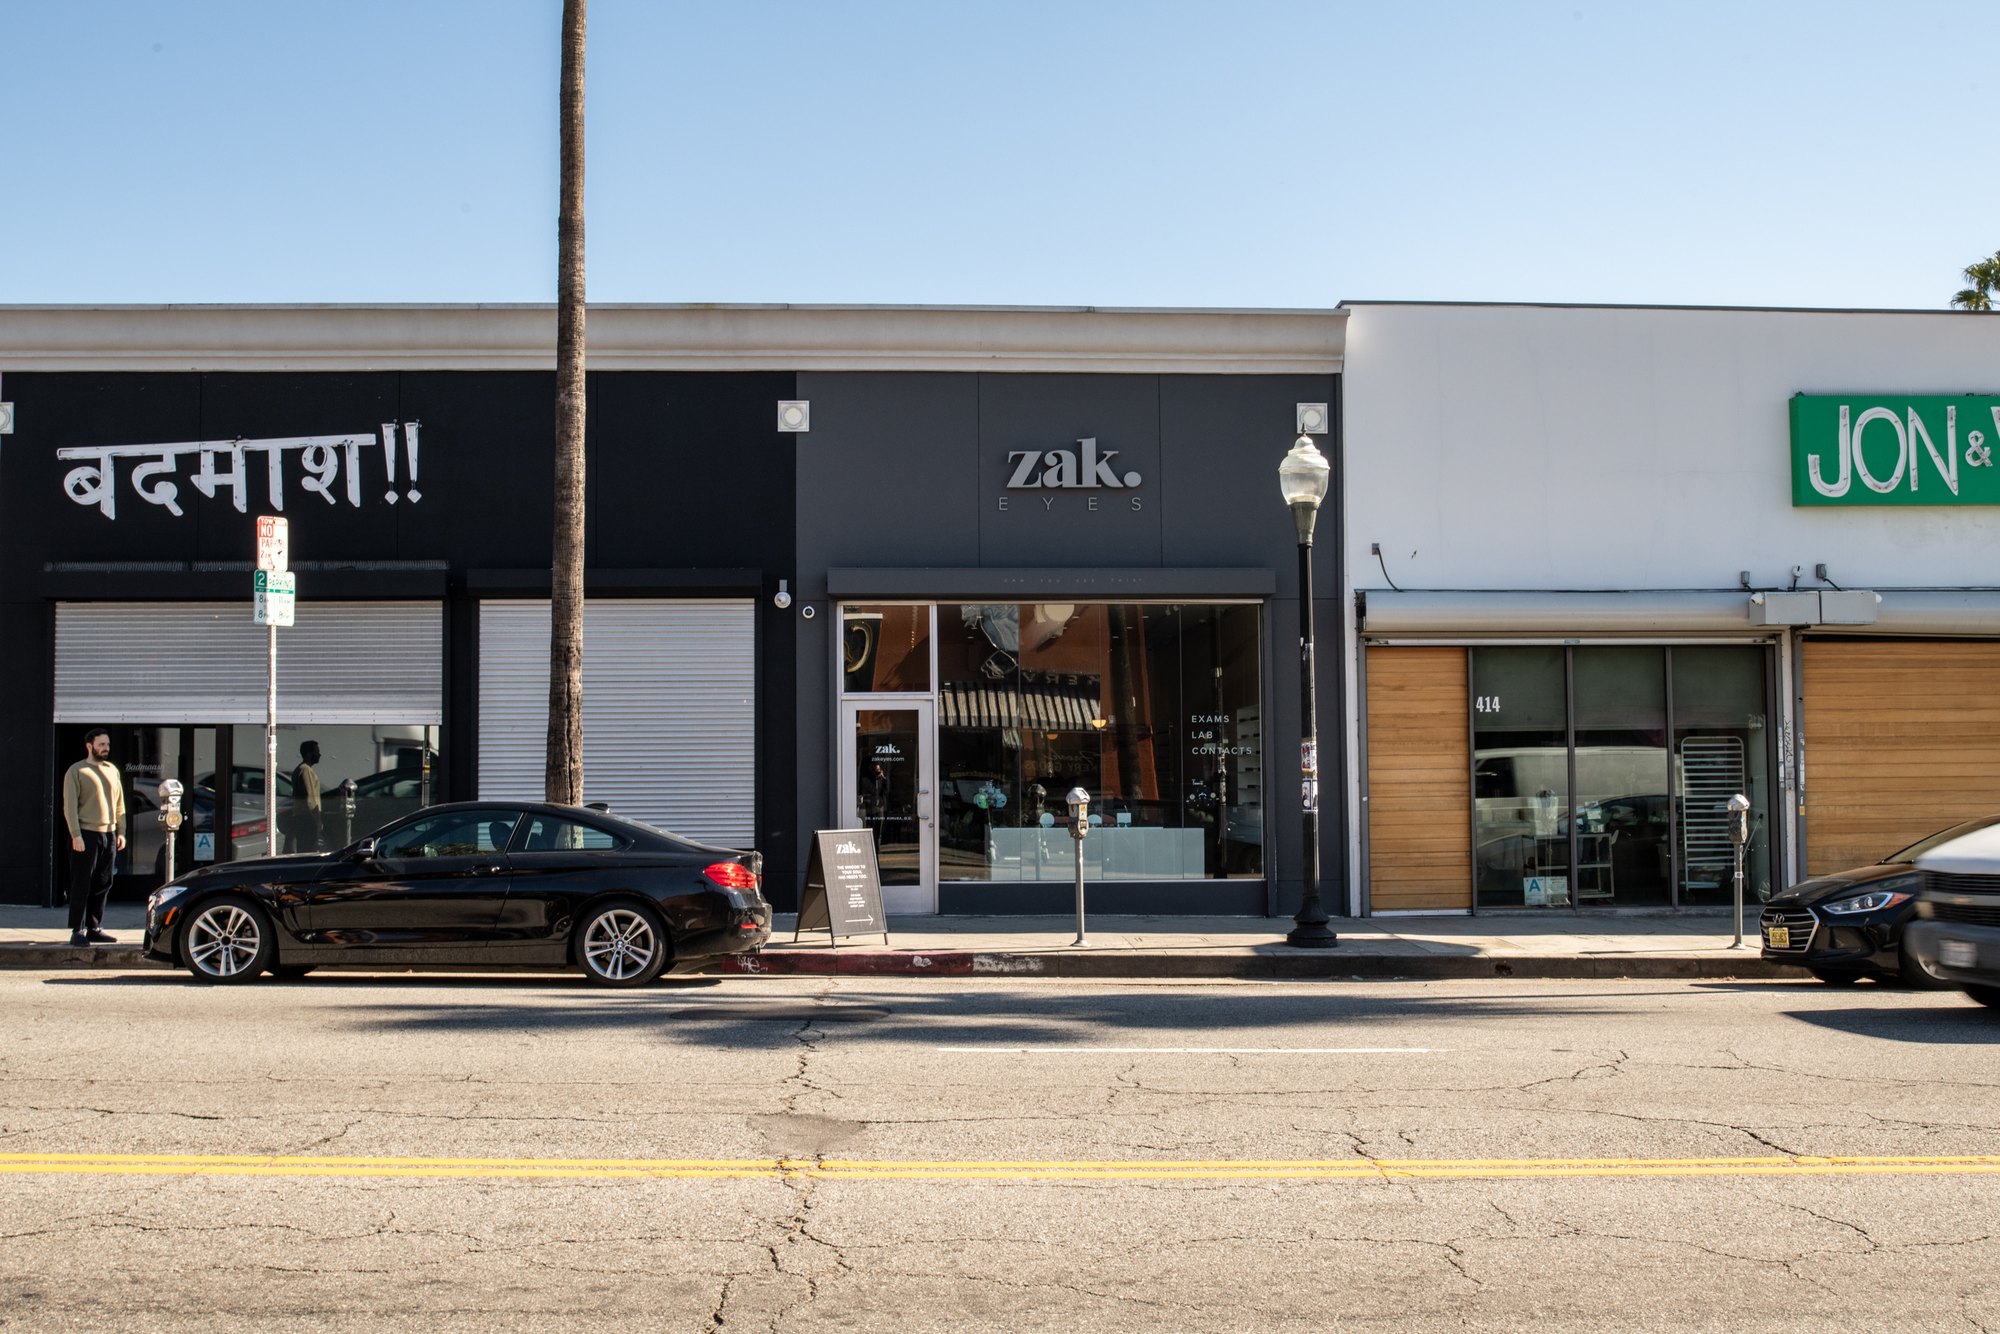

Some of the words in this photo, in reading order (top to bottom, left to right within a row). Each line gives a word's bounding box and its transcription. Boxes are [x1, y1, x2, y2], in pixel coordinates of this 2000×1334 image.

[1807, 405, 1960, 498] JON
[1965, 430, 1993, 468] &
[1006, 437, 1142, 488] zak.
[998, 496, 1143, 511] EYES
[261, 525, 273, 537] NO
[258, 572, 265, 586] 2
[1475, 696, 1501, 713] 414
[1191, 715, 1230, 723] EXAMS
[1191, 731, 1213, 739] LAB
[875, 743, 900, 754] zak.
[1191, 747, 1252, 755] CONTACTS
[198, 834, 211, 848] A
[836, 841, 861, 854] zak.
[1529, 878, 1541, 892] A
